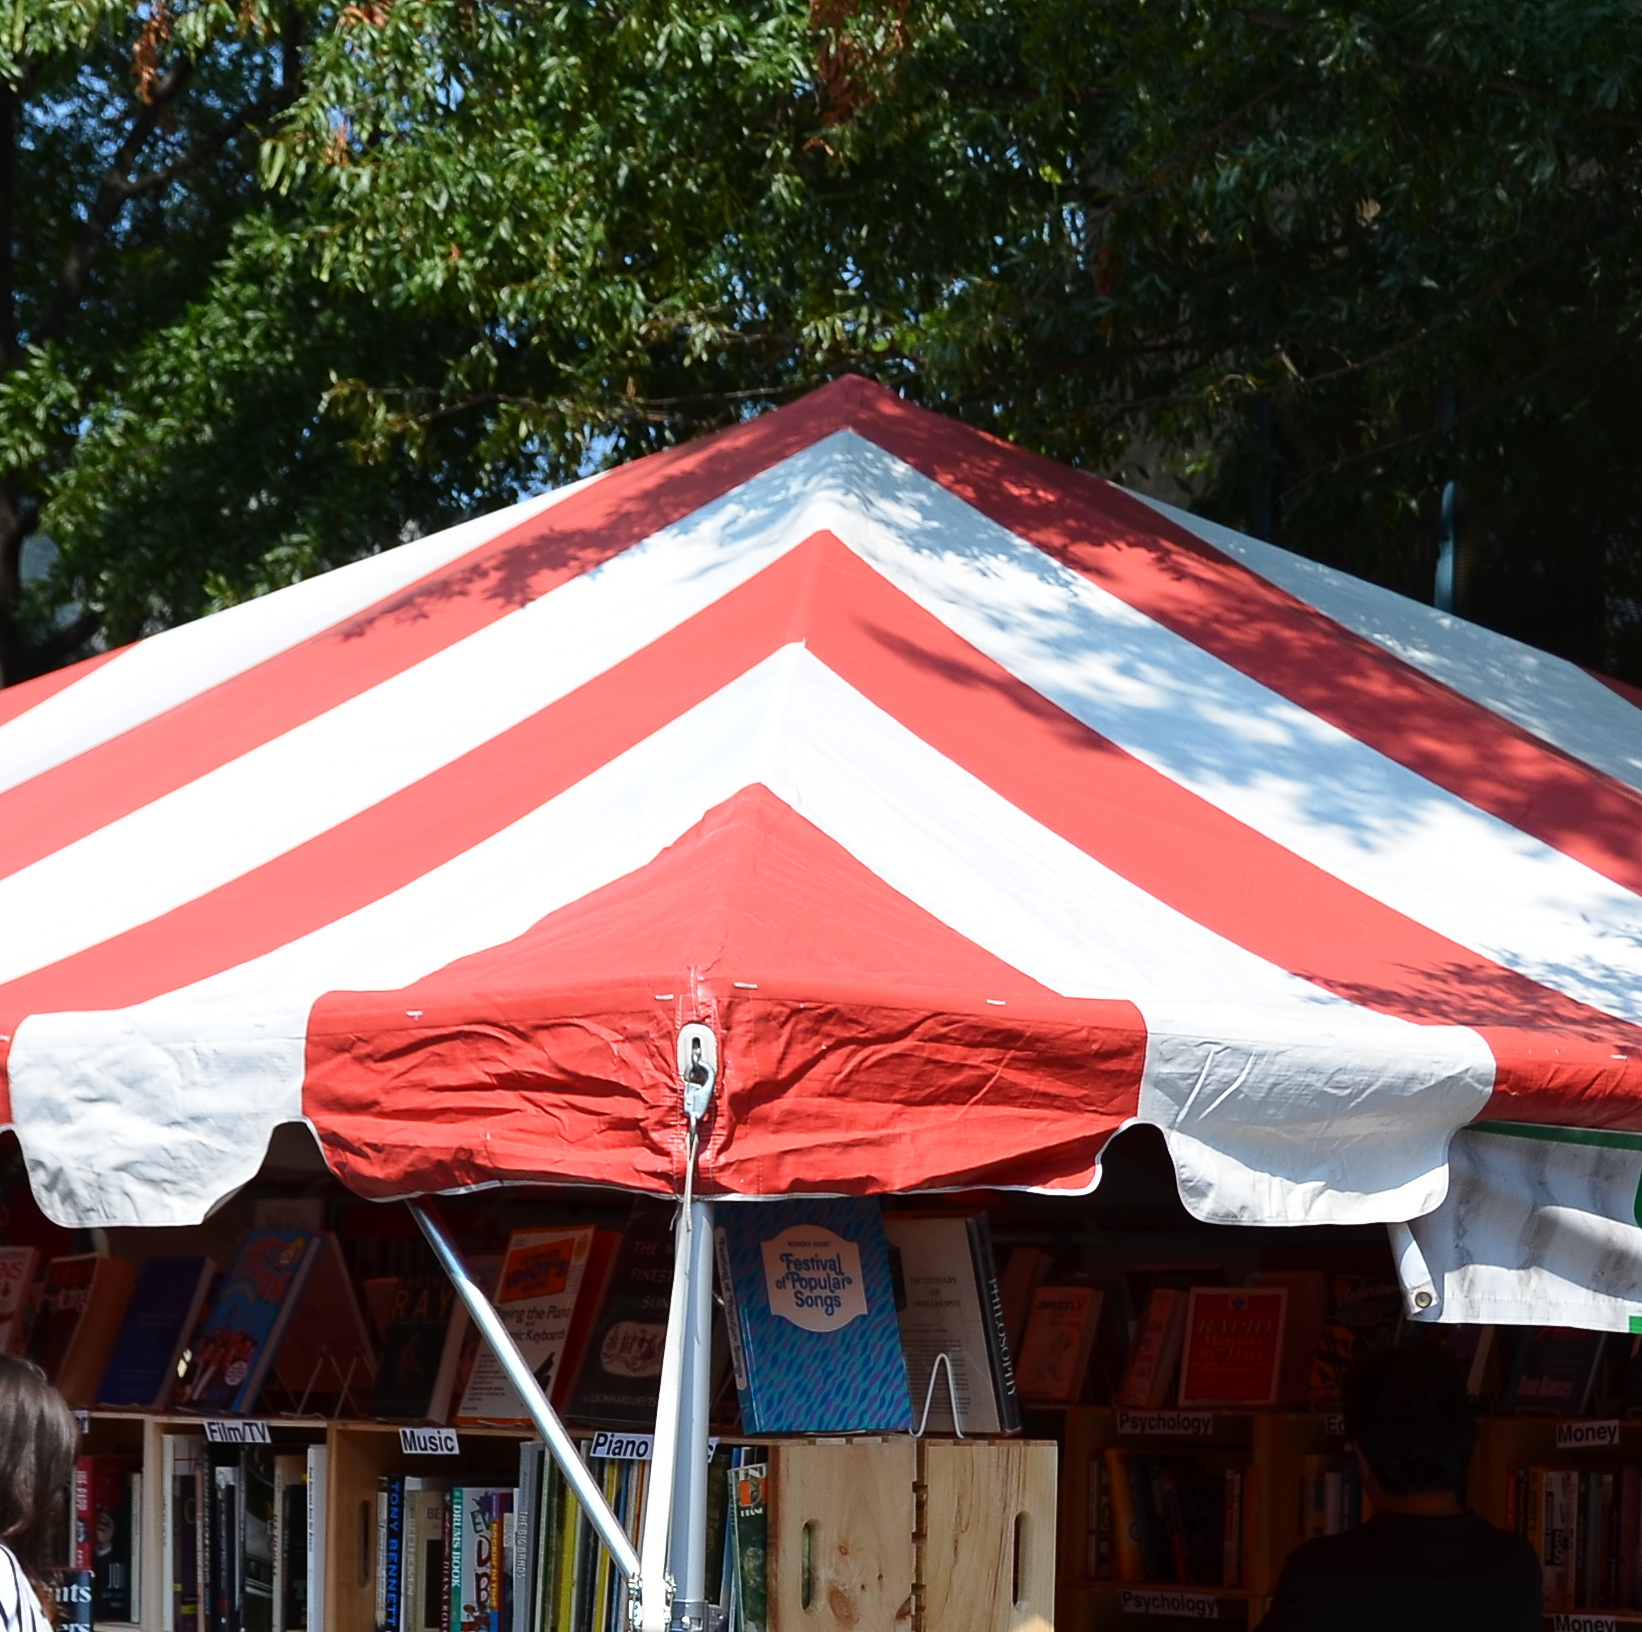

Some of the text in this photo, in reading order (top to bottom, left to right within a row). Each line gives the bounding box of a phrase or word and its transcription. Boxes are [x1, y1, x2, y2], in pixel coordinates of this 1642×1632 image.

[781, 1254, 844, 1276] Festival
[776, 1271, 852, 1296] of Popular
[390, 1289, 457, 1320] RAY
[794, 1292, 842, 1315] Songs
[207, 1424, 269, 1443] Film/TV
[1119, 1413, 1211, 1434] Psychology
[1558, 1422, 1618, 1445] Money
[401, 1430, 456, 1453] Music
[592, 1433, 650, 1458] Piano
[386, 1481, 400, 1627] TONY BENNETT
[451, 1504, 460, 1587] DRUMS BOOK
[516, 1511, 528, 1578] THE BIG BANDS
[441, 1561, 449, 1600] DIANA
[1122, 1591, 1217, 1617] Psychology
